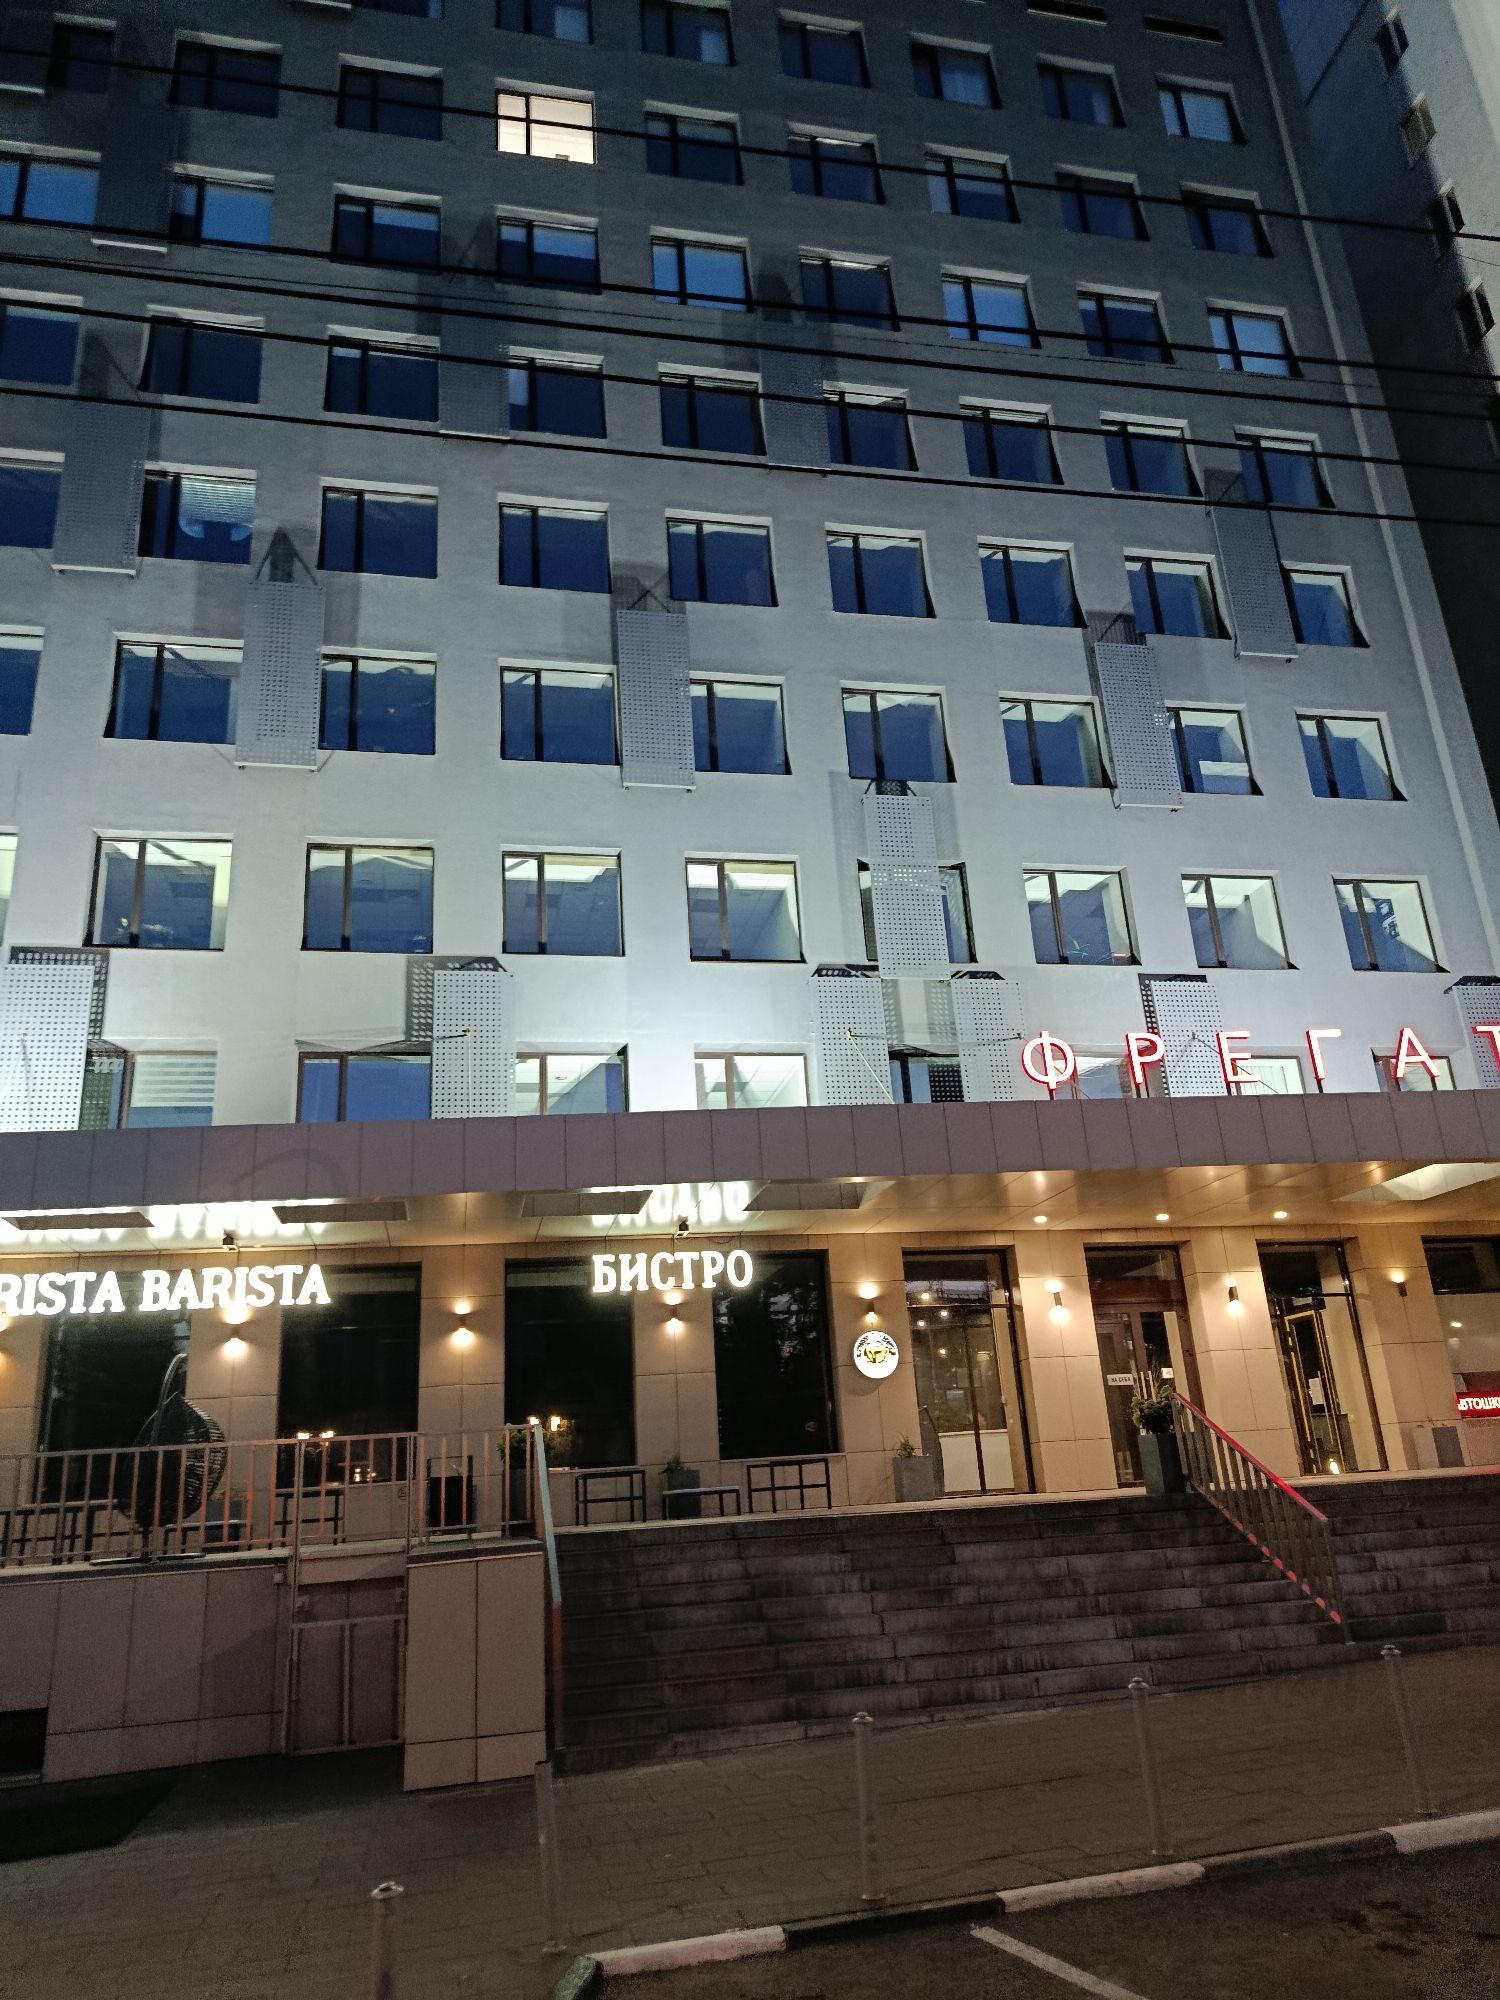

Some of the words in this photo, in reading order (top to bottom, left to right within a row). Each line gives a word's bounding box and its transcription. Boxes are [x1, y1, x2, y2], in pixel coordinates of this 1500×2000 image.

[0, 1271, 125, 1316] RISTA
[139, 1264, 331, 1311] BARISTA
[592, 1250, 753, 1293] БИСТРО
